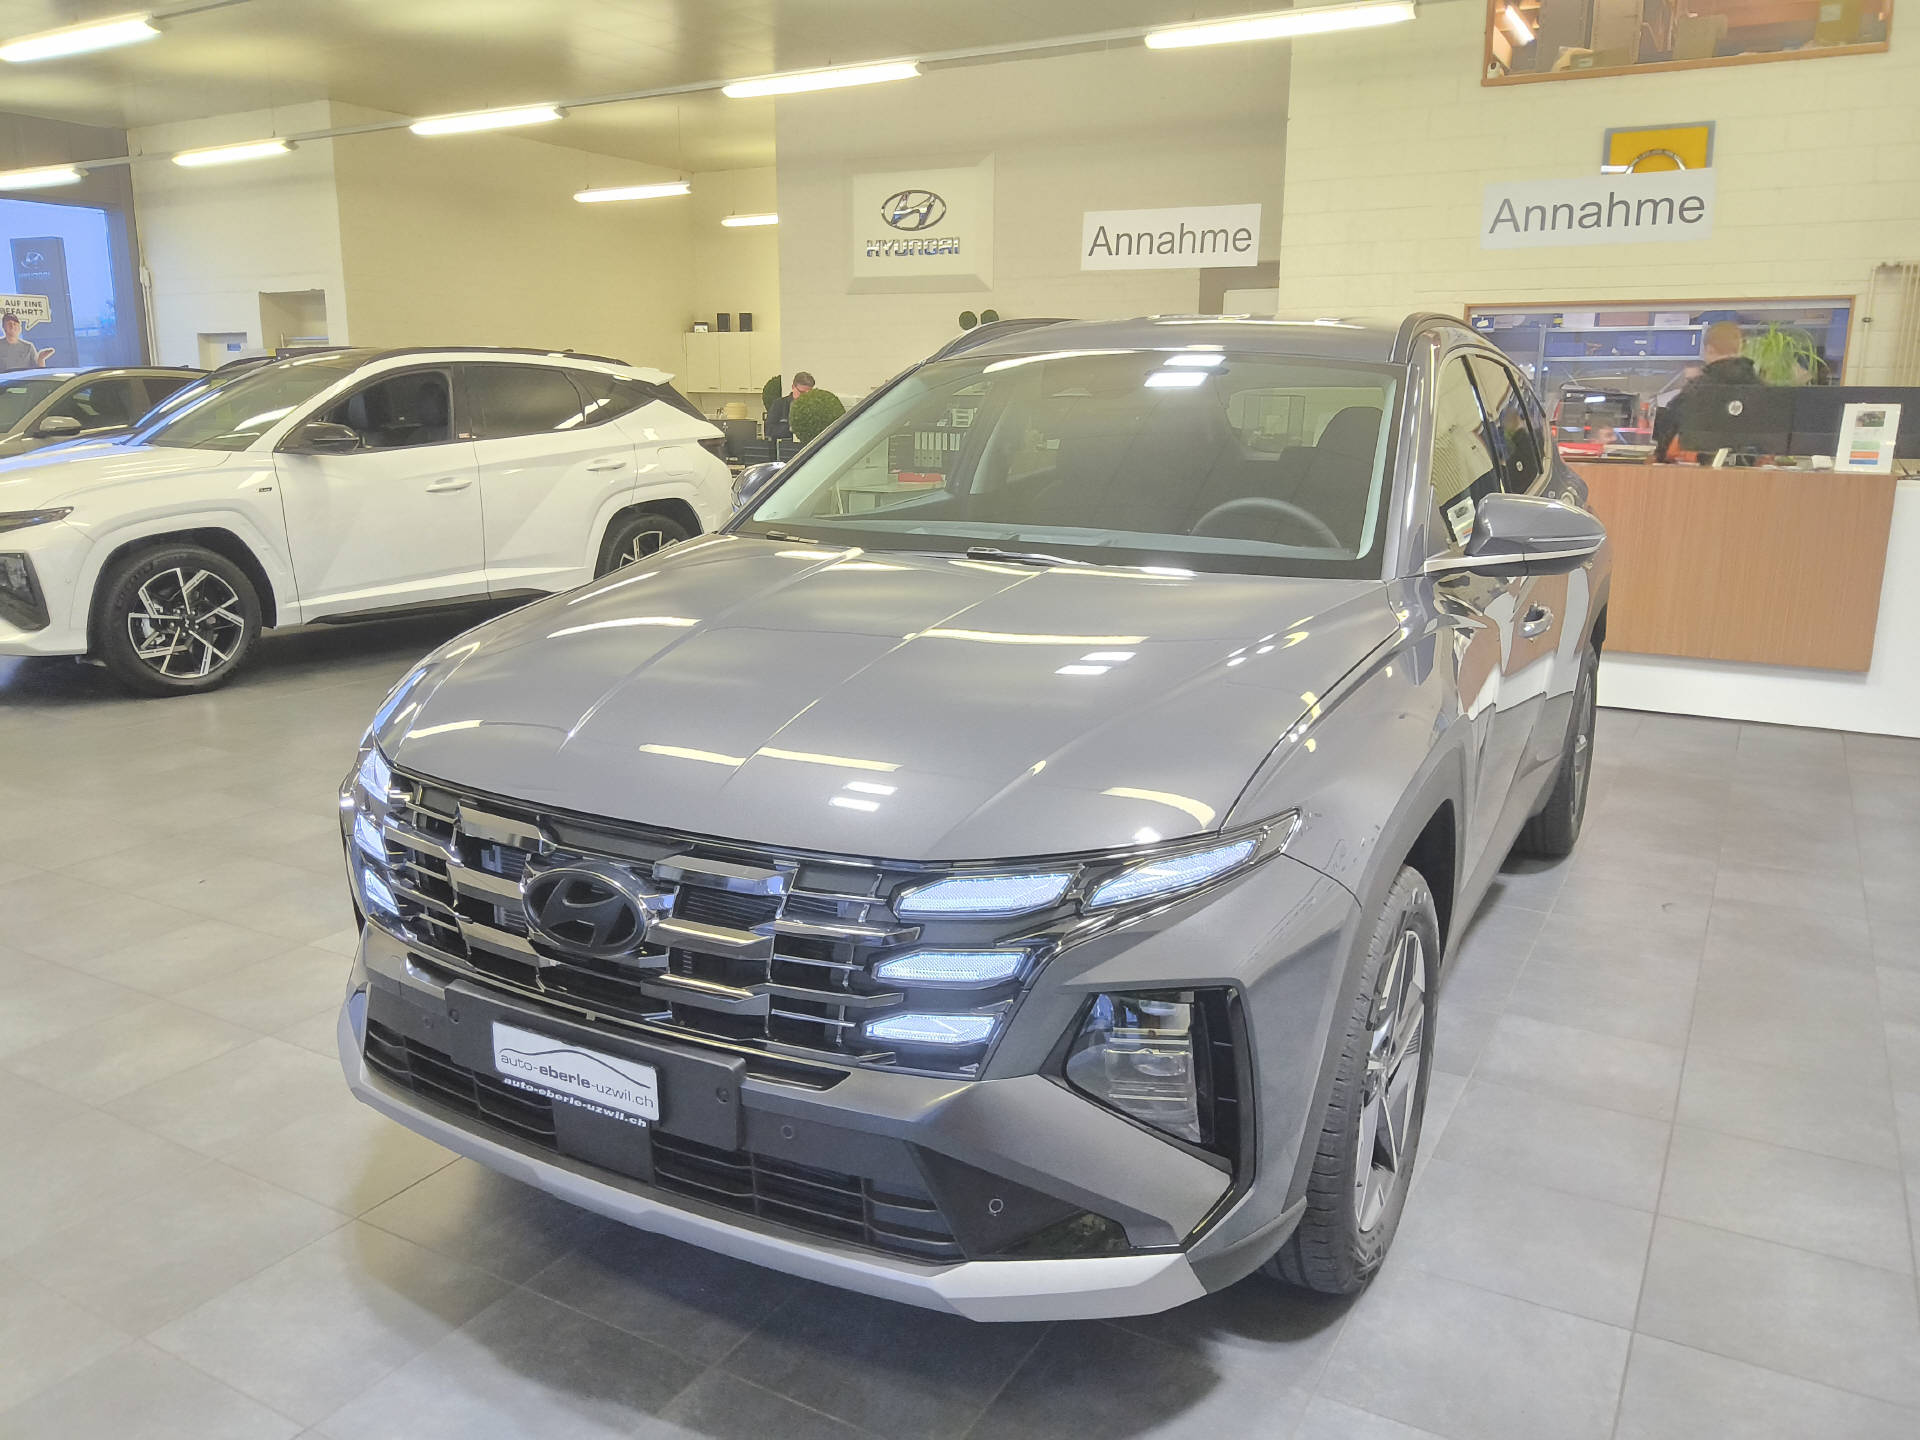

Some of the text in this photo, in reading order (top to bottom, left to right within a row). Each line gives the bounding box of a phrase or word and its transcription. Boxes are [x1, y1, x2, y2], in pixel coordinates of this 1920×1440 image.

[1489, 191, 1705, 234] Annahme
[866, 237, 960, 257] HYUNDAI
[1088, 223, 1252, 257] Annahme
[5, 299, 43, 308] AUF EINE
[500, 1054, 654, 1109] auto-eberle-uzwil.ch
[503, 1077, 647, 1127] auto-eberle-uzwil.ch
